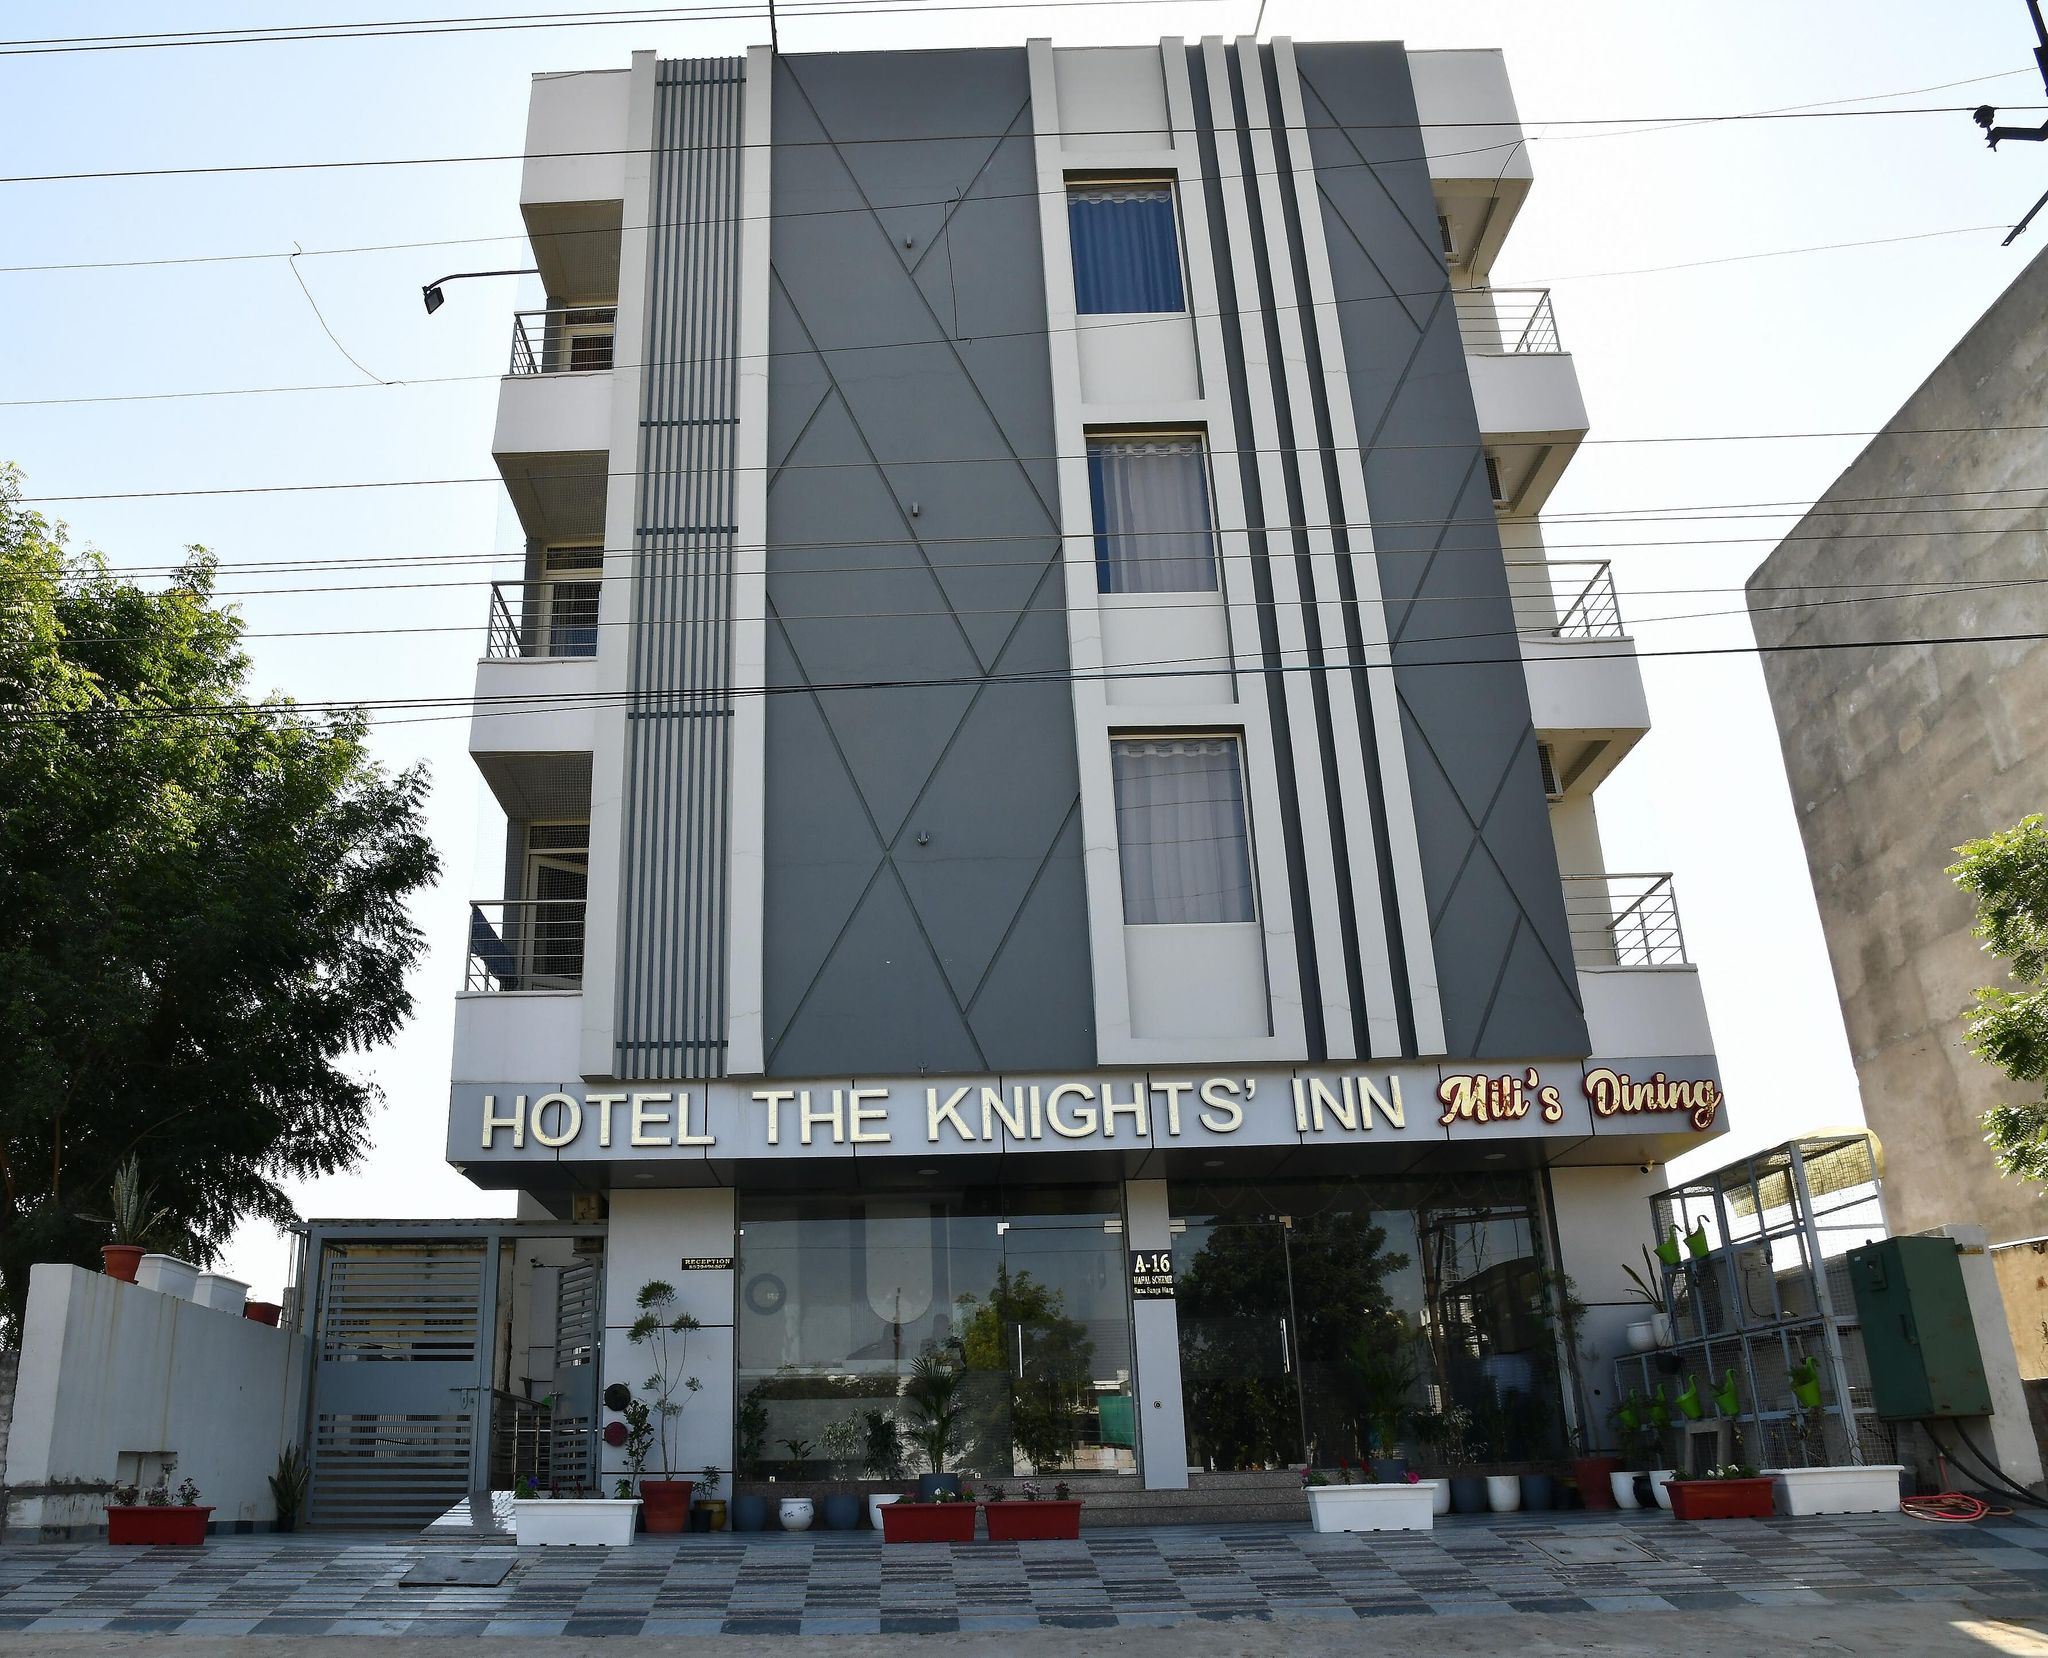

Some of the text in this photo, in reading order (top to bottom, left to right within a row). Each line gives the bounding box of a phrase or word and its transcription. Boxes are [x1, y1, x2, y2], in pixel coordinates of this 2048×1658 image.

[482, 1075, 1406, 1148] HOTEL THE KNIGHTS' INN
[1438, 1067, 1723, 1131] Mili's Dining
[1134, 1254, 1170, 1273] A-16
